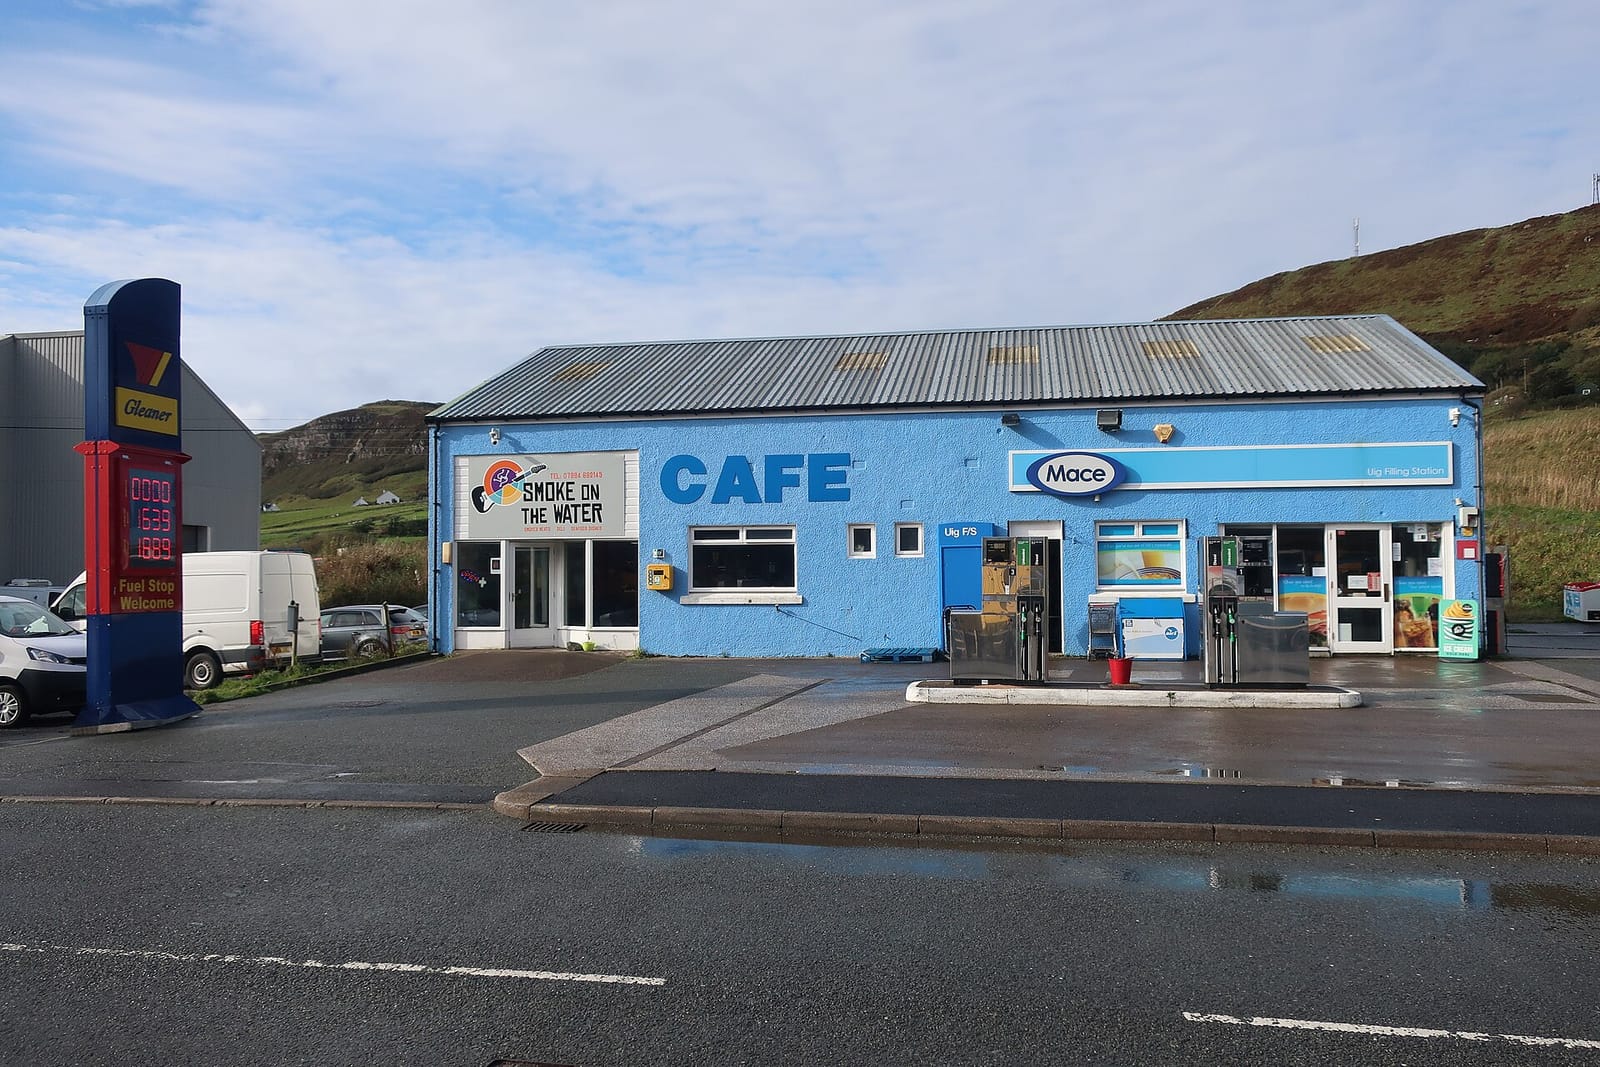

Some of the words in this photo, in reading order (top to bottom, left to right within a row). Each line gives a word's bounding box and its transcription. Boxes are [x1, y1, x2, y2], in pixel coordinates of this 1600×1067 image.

[124, 399, 173, 422] Gleaner
[660, 453, 851, 504] CAFE
[1046, 464, 1106, 482] Mace
[1367, 467, 1383, 477] Uig
[1384, 467, 1410, 477] Filling
[1411, 466, 1445, 475] Station
[131, 477, 171, 503] 0000
[523, 482, 576, 502] SMOKE
[581, 484, 600, 501] ON
[138, 507, 171, 532] 1639
[521, 508, 548, 525] THE
[553, 503, 603, 524] WATER
[944, 527, 960, 538] Uig
[962, 527, 978, 537] F/S
[138, 537, 171, 560] 1889
[119, 578, 145, 593] Fuel
[148, 579, 175, 596] Stop
[120, 596, 175, 610] Welcome
